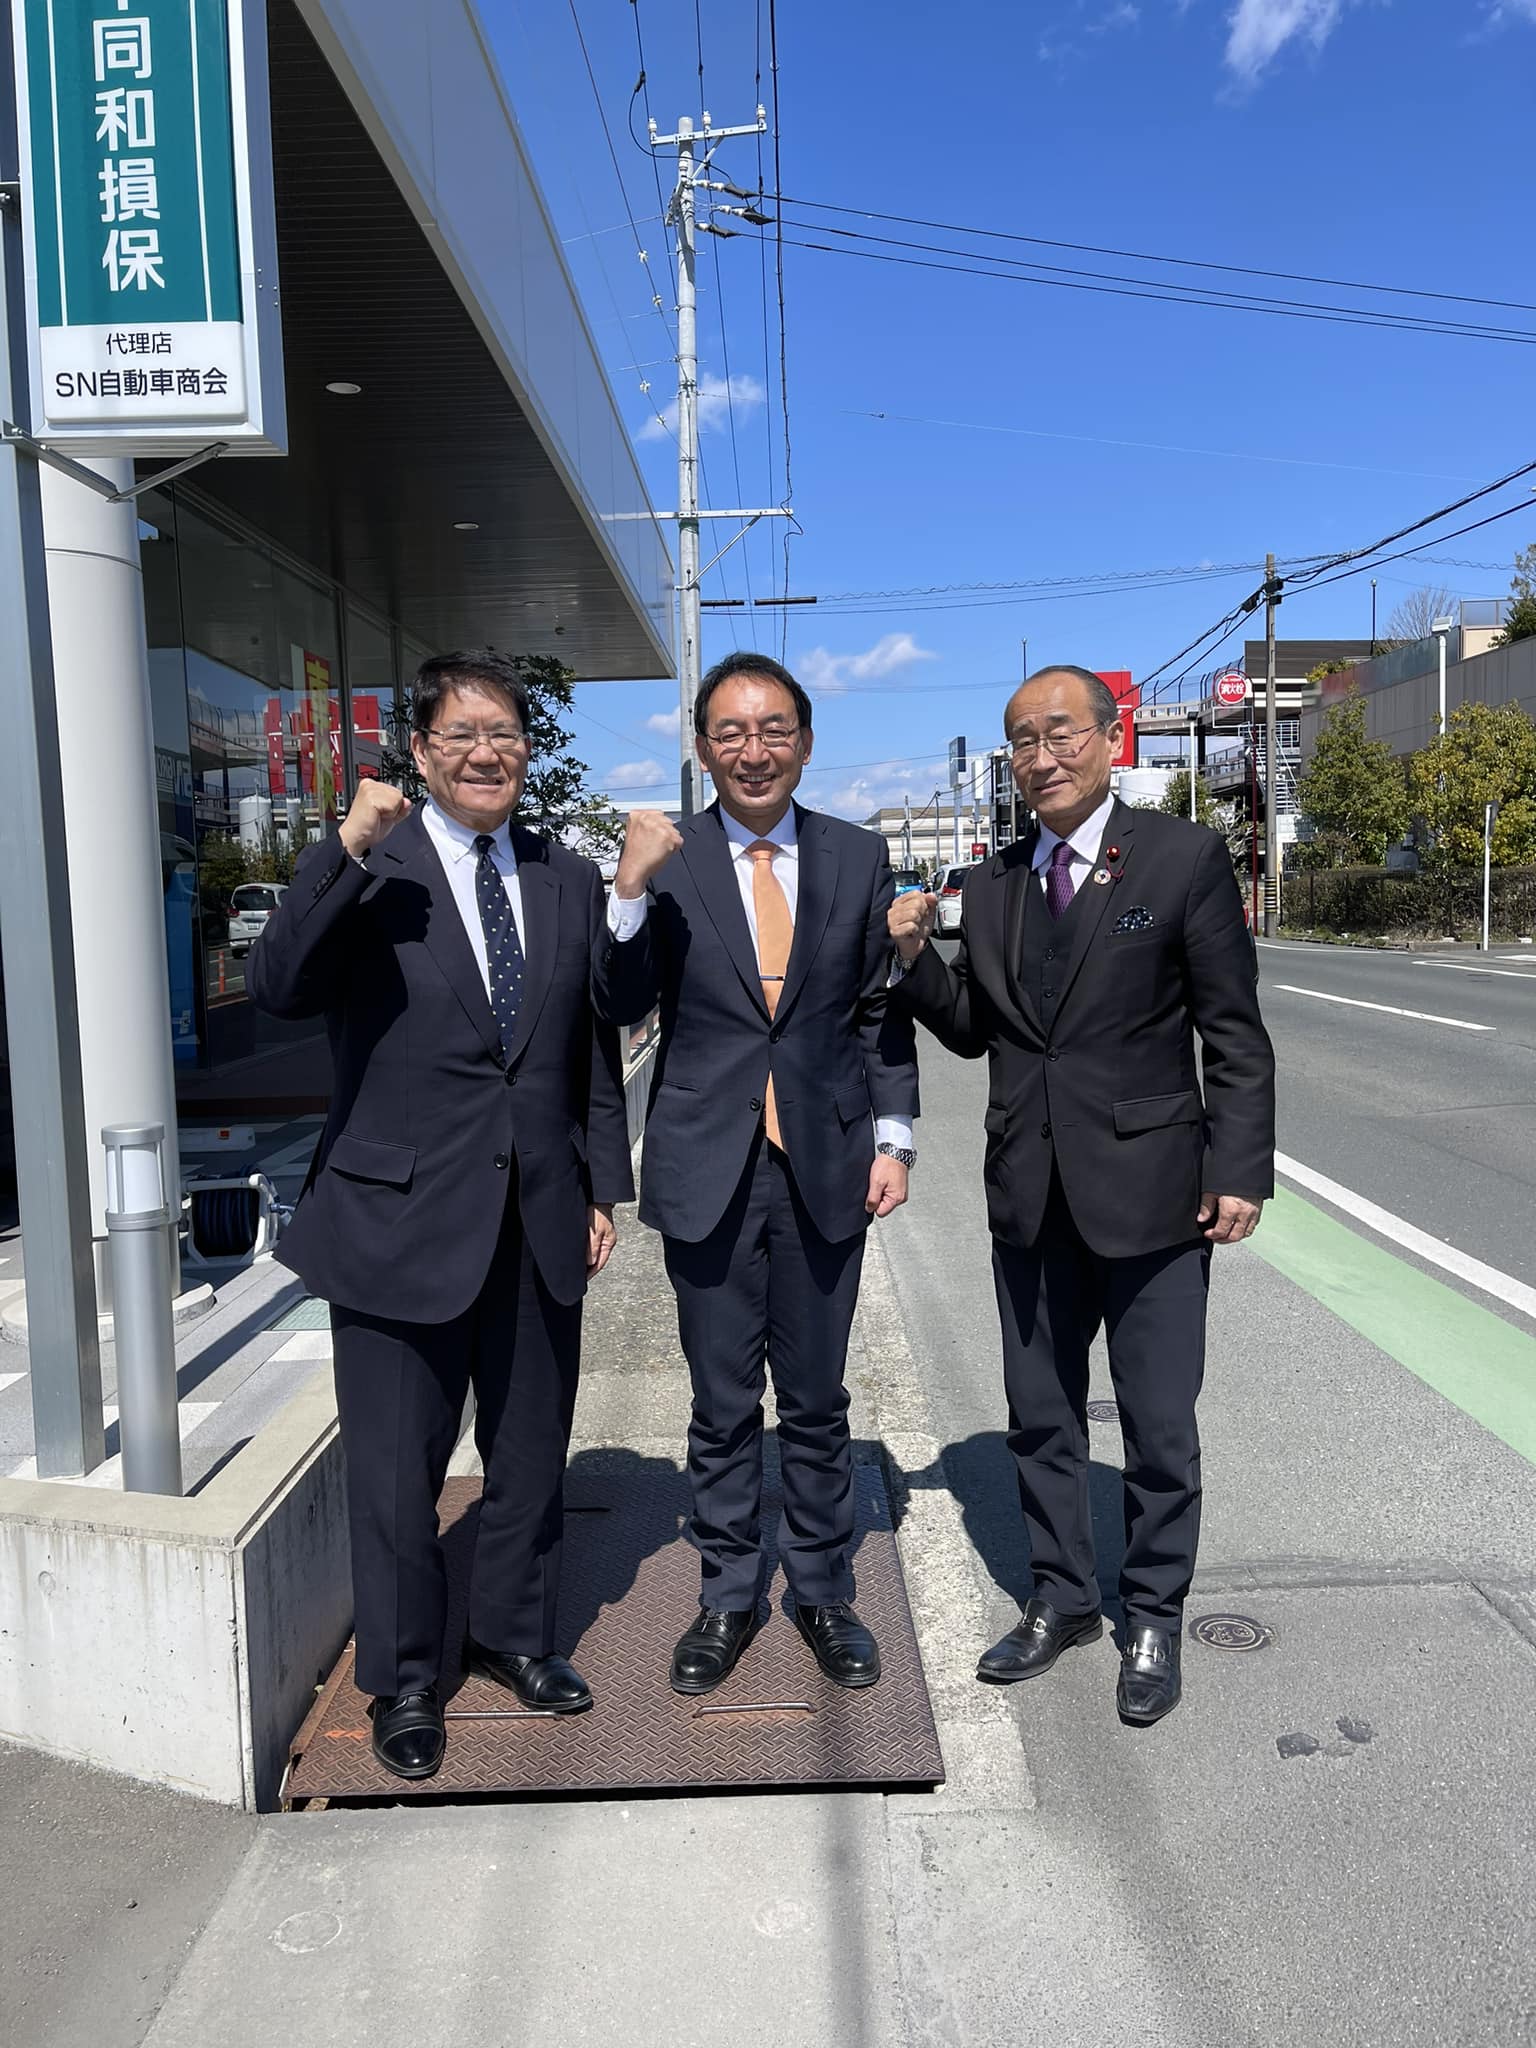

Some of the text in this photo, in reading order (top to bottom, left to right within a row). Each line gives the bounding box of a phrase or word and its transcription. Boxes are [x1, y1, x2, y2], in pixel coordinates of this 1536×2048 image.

[92, 0, 165, 292] 同和損保
[106, 332, 172, 355] 代理店
[55, 367, 228, 397] SN自動車商会
